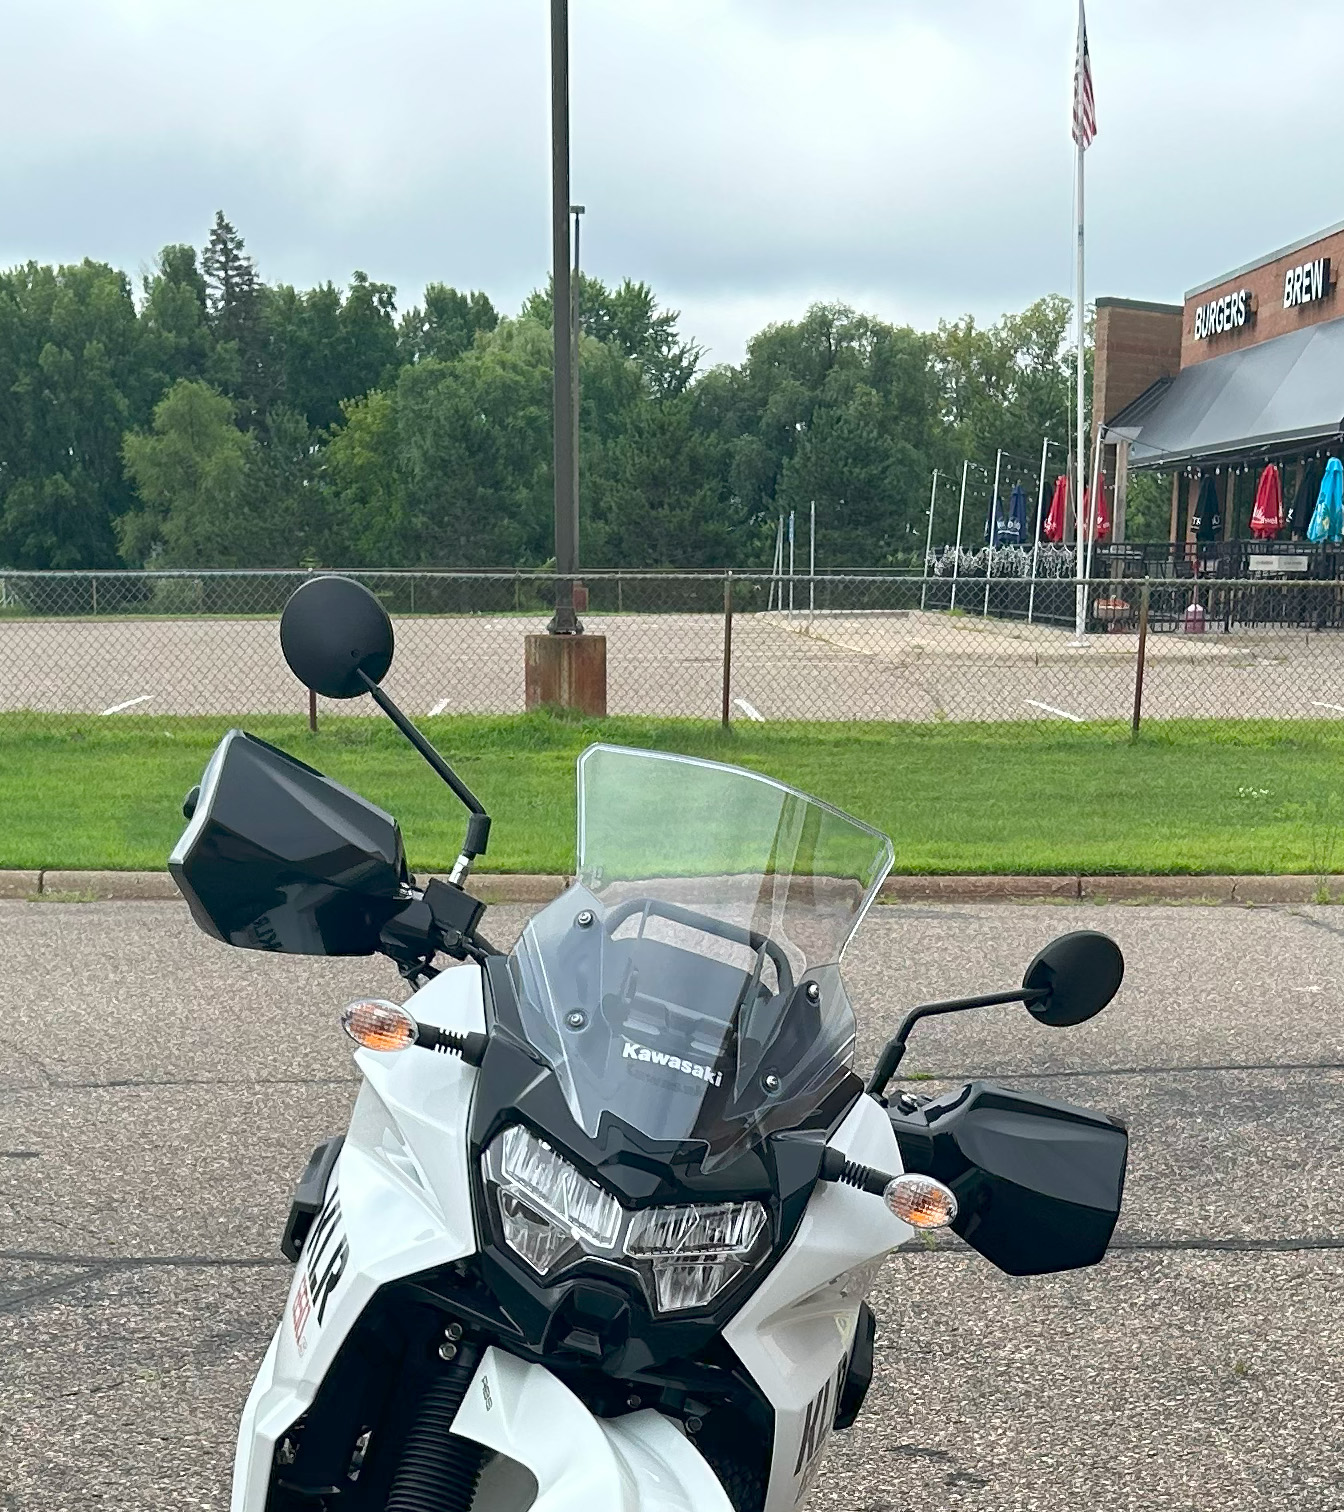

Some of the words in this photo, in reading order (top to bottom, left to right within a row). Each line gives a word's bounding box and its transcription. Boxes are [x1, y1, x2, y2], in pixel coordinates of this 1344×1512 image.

[1194, 289, 1246, 341] BURGERS
[1283, 257, 1326, 309] BREW
[622, 1042, 723, 1087] Kawasaki
[307, 1185, 350, 1328] KLR
